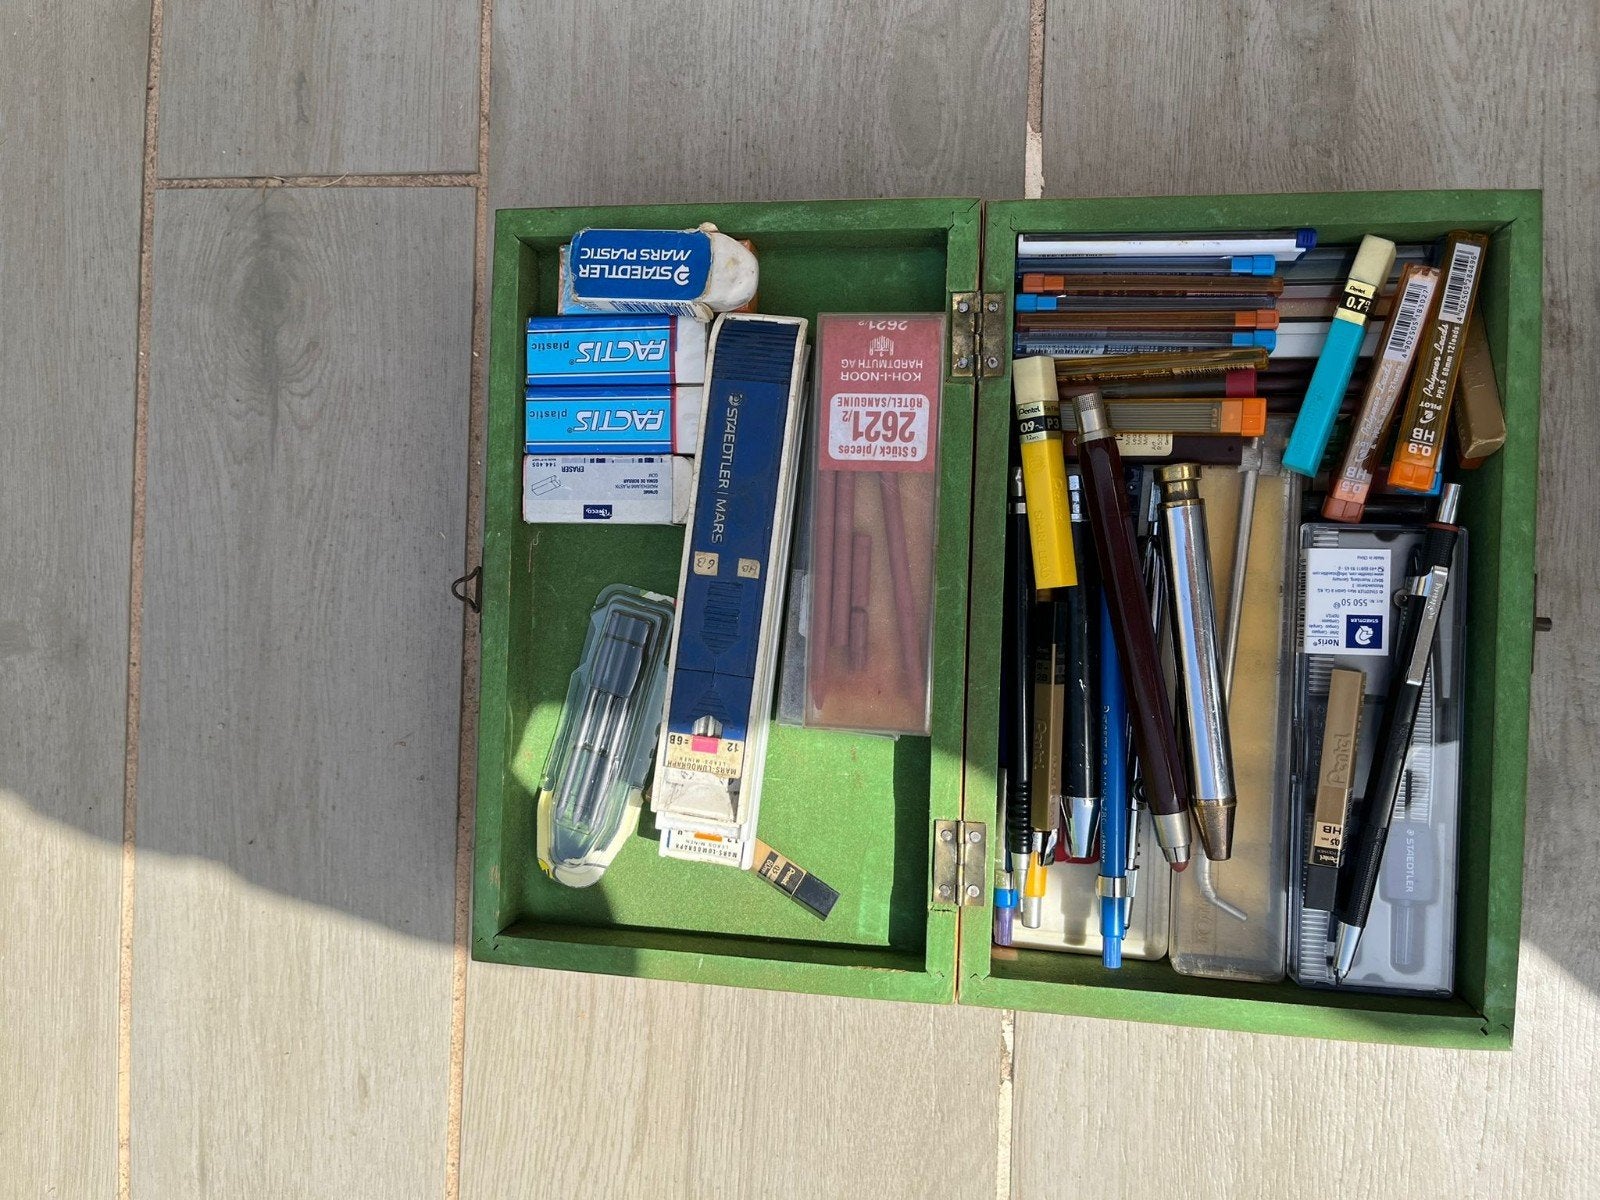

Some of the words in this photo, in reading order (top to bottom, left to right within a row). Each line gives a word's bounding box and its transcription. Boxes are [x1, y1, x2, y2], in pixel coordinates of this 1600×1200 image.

[580, 248, 637, 260] PLASTIC
[640, 249, 692, 260] MARS
[579, 264, 672, 280] STAEDTLER
[1403, 320, 1419, 350] 902505
[531, 342, 570, 350] plastic
[841, 359, 855, 368] AG
[858, 359, 923, 368] HARDTMUTH
[1422, 355, 1441, 397] Polymer
[1433, 323, 1450, 354] Leads
[840, 371, 922, 381] KOH-I-NOOR
[1419, 400, 1441, 410] PILOT
[529, 409, 568, 418] plastic
[1412, 427, 1435, 441] HB
[718, 407, 738, 489] STAEDTLER
[879, 446, 908, 458] Stück
[911, 446, 917, 457] 6
[1408, 442, 1431, 457] 0.9
[711, 498, 726, 544] MARS
[727, 742, 739, 752] 12
[1325, 732, 1352, 786] Pentel
[1322, 825, 1342, 835] HB
[1404, 837, 1415, 893] STAEDTLER
